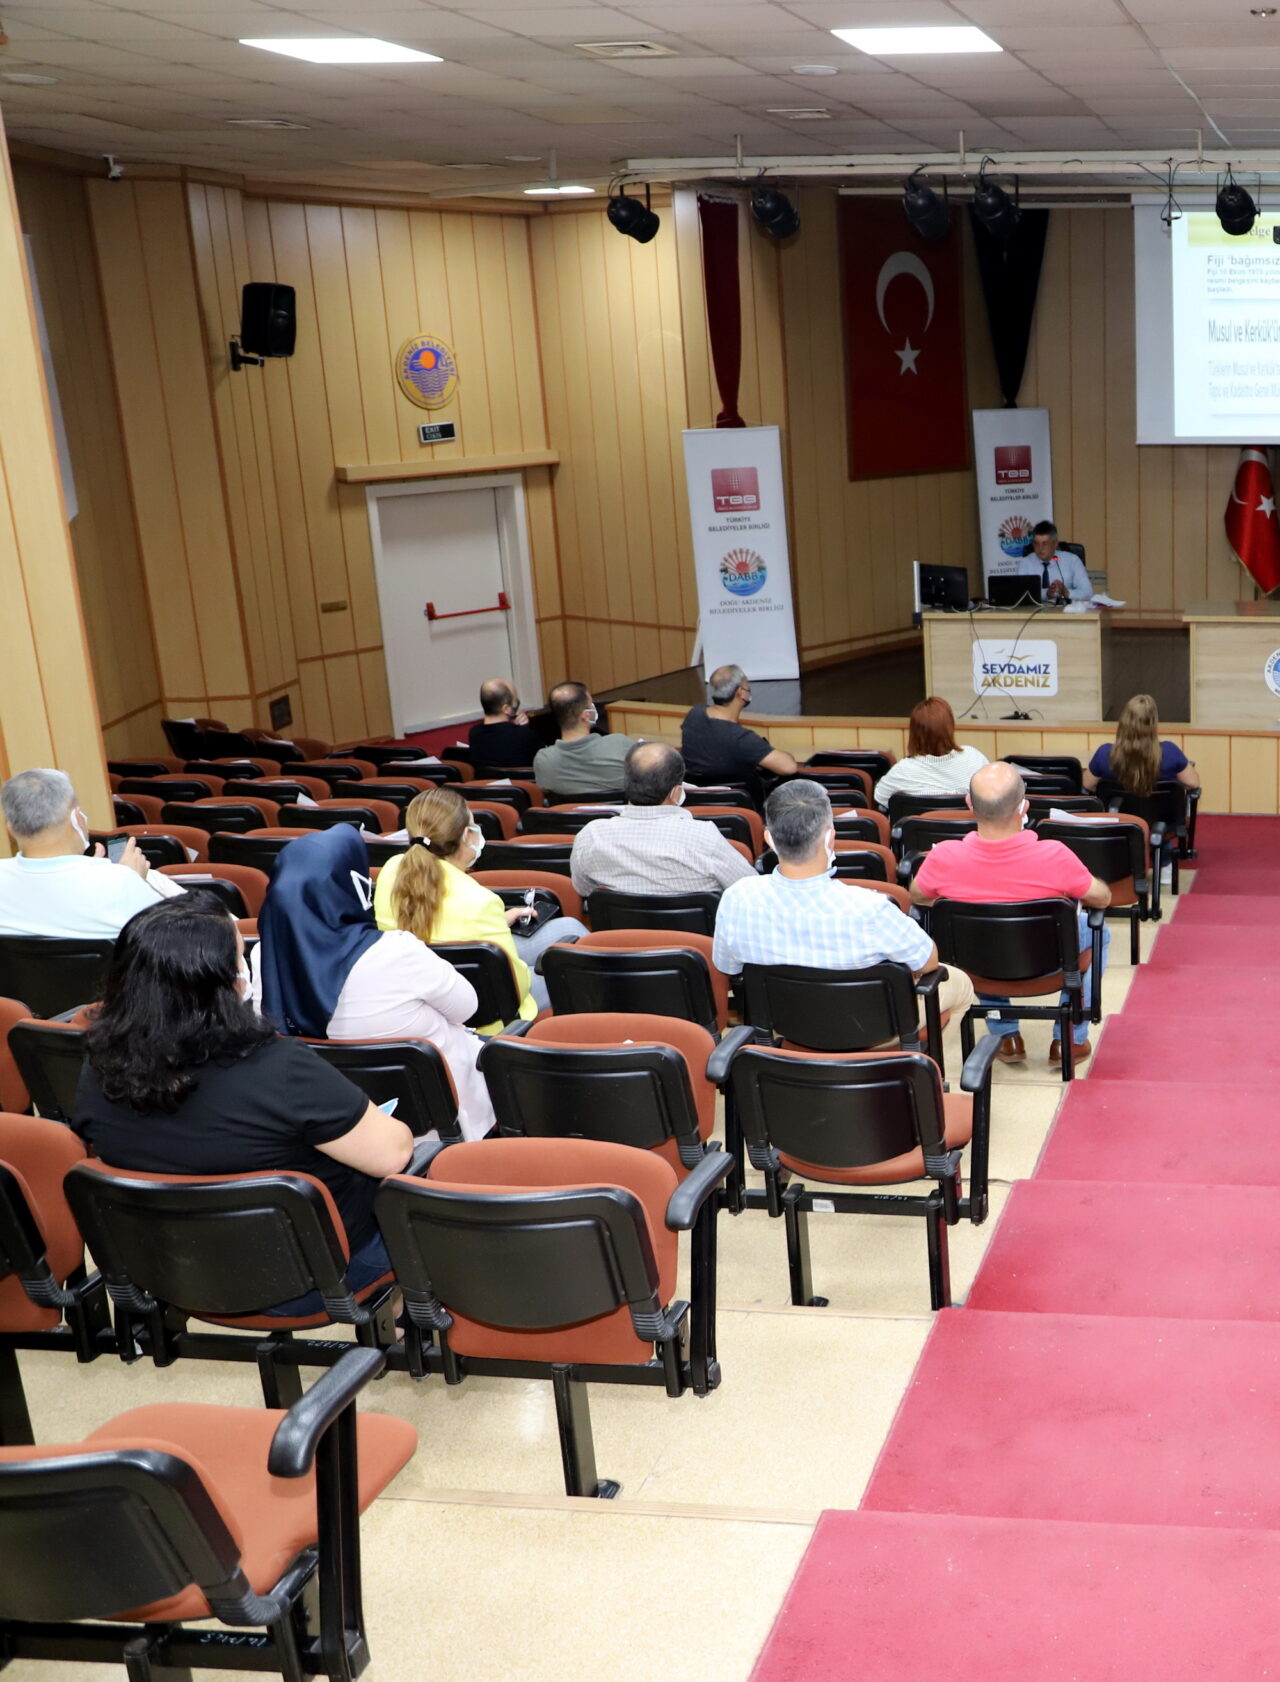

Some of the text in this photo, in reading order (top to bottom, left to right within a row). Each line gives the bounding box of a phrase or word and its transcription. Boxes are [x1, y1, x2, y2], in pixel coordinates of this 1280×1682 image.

[1248, 224, 1271, 239] elge
[1207, 255, 1224, 268] Fiji
[1208, 319, 1232, 343] Musul
[1233, 325, 1243, 343] ve
[997, 469, 1030, 478] TBB
[716, 494, 757, 505] TBB
[728, 572, 759, 582] DABB
[982, 663, 1051, 675] SEVDAMIZ
[981, 674, 1051, 688] AKDENİZ
